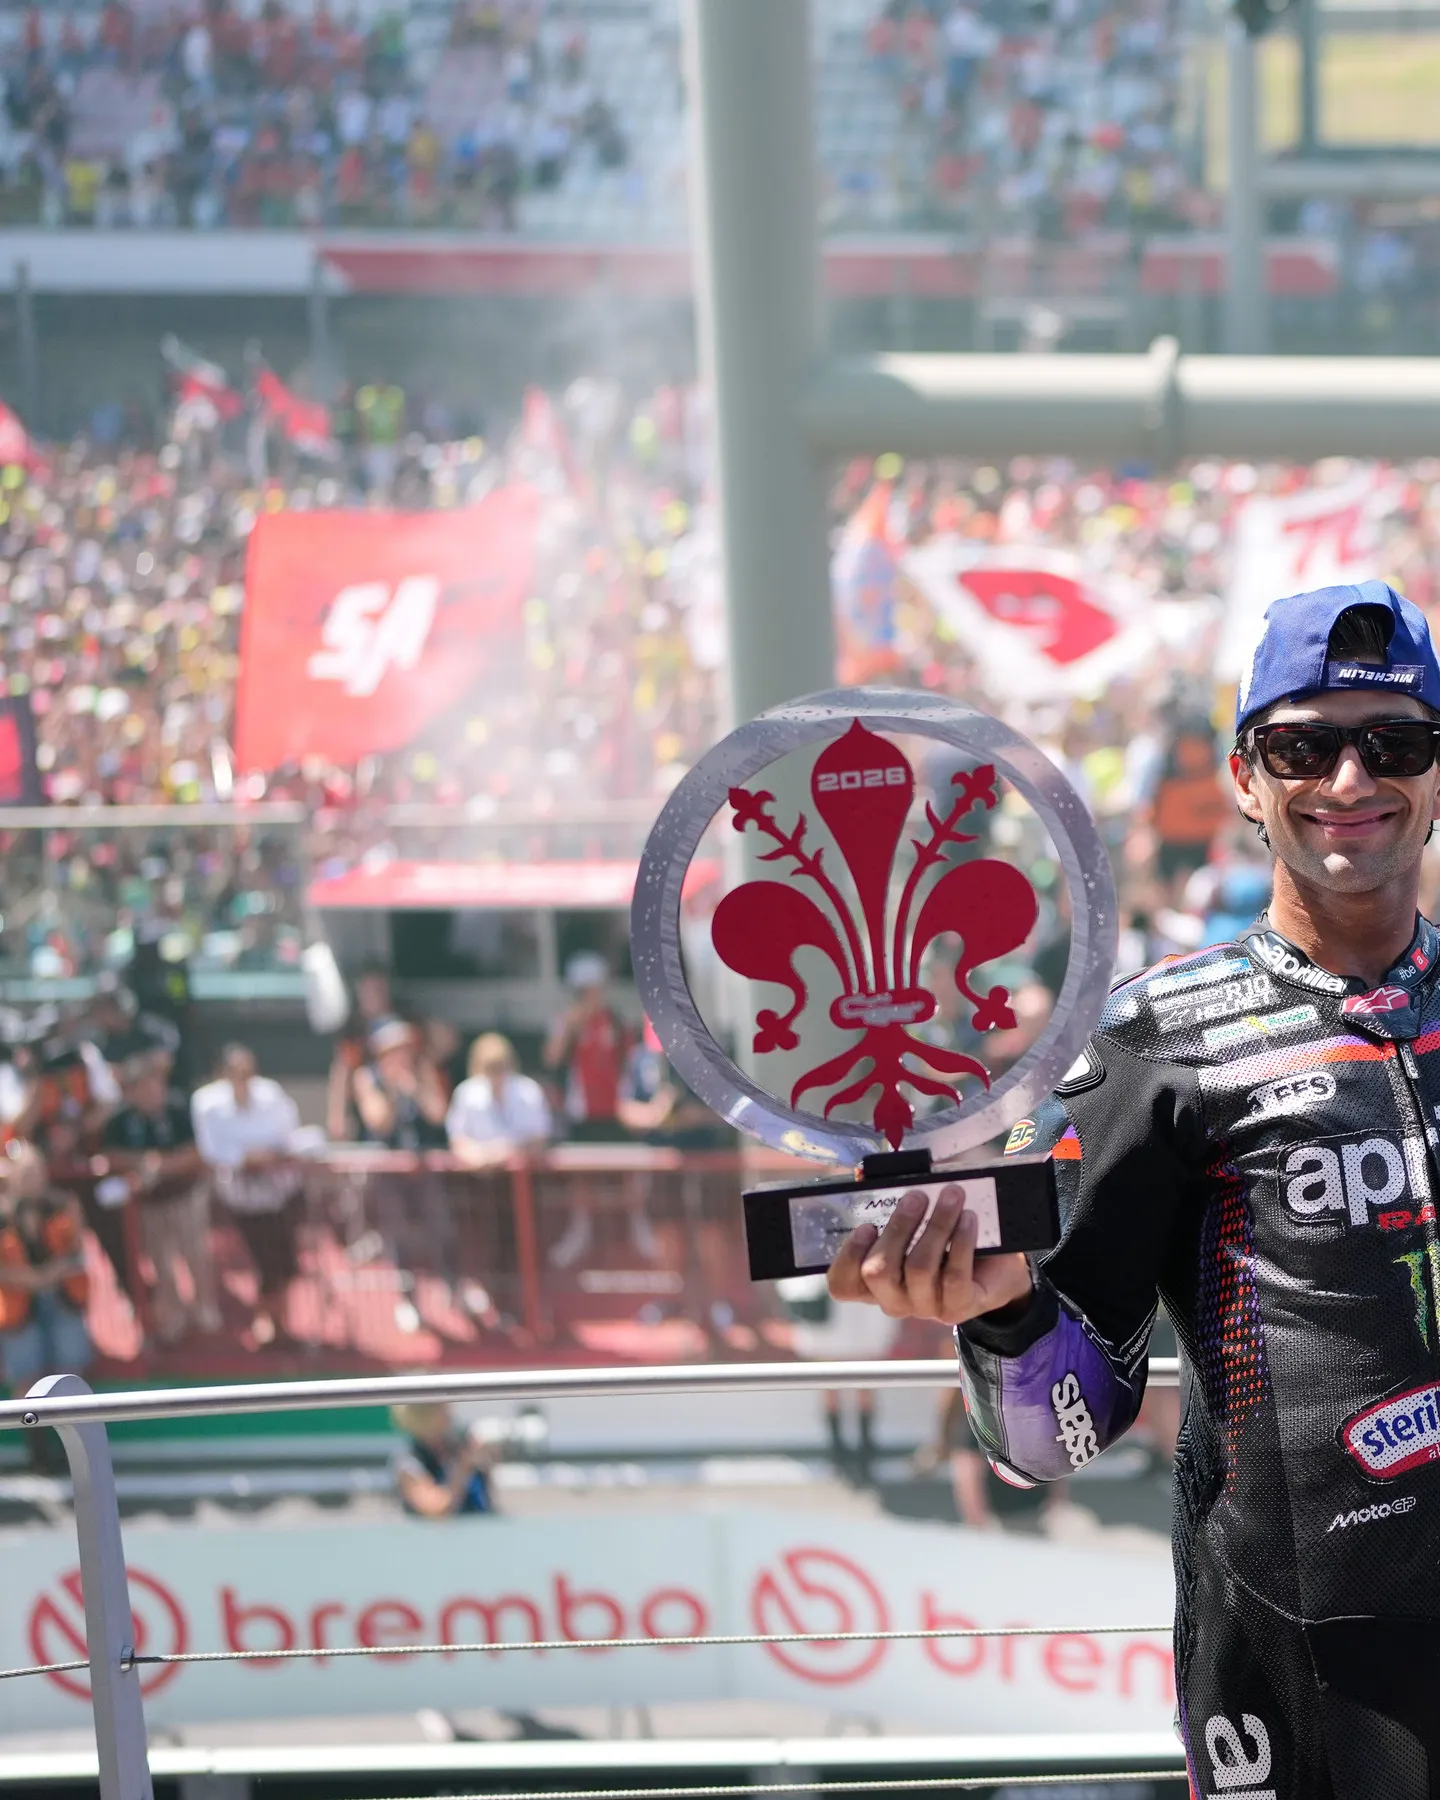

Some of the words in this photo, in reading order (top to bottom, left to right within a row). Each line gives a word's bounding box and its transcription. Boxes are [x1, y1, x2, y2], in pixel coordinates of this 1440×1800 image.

[1338, 668, 1415, 684] MICHELIN
[1265, 946, 1347, 993] aprilia
[1196, 992, 1271, 1020] HELMET
[865, 1196, 901, 1210] Mot
[1326, 1496, 1417, 1533] MotoGP
[218, 1570, 711, 1668] brembo
